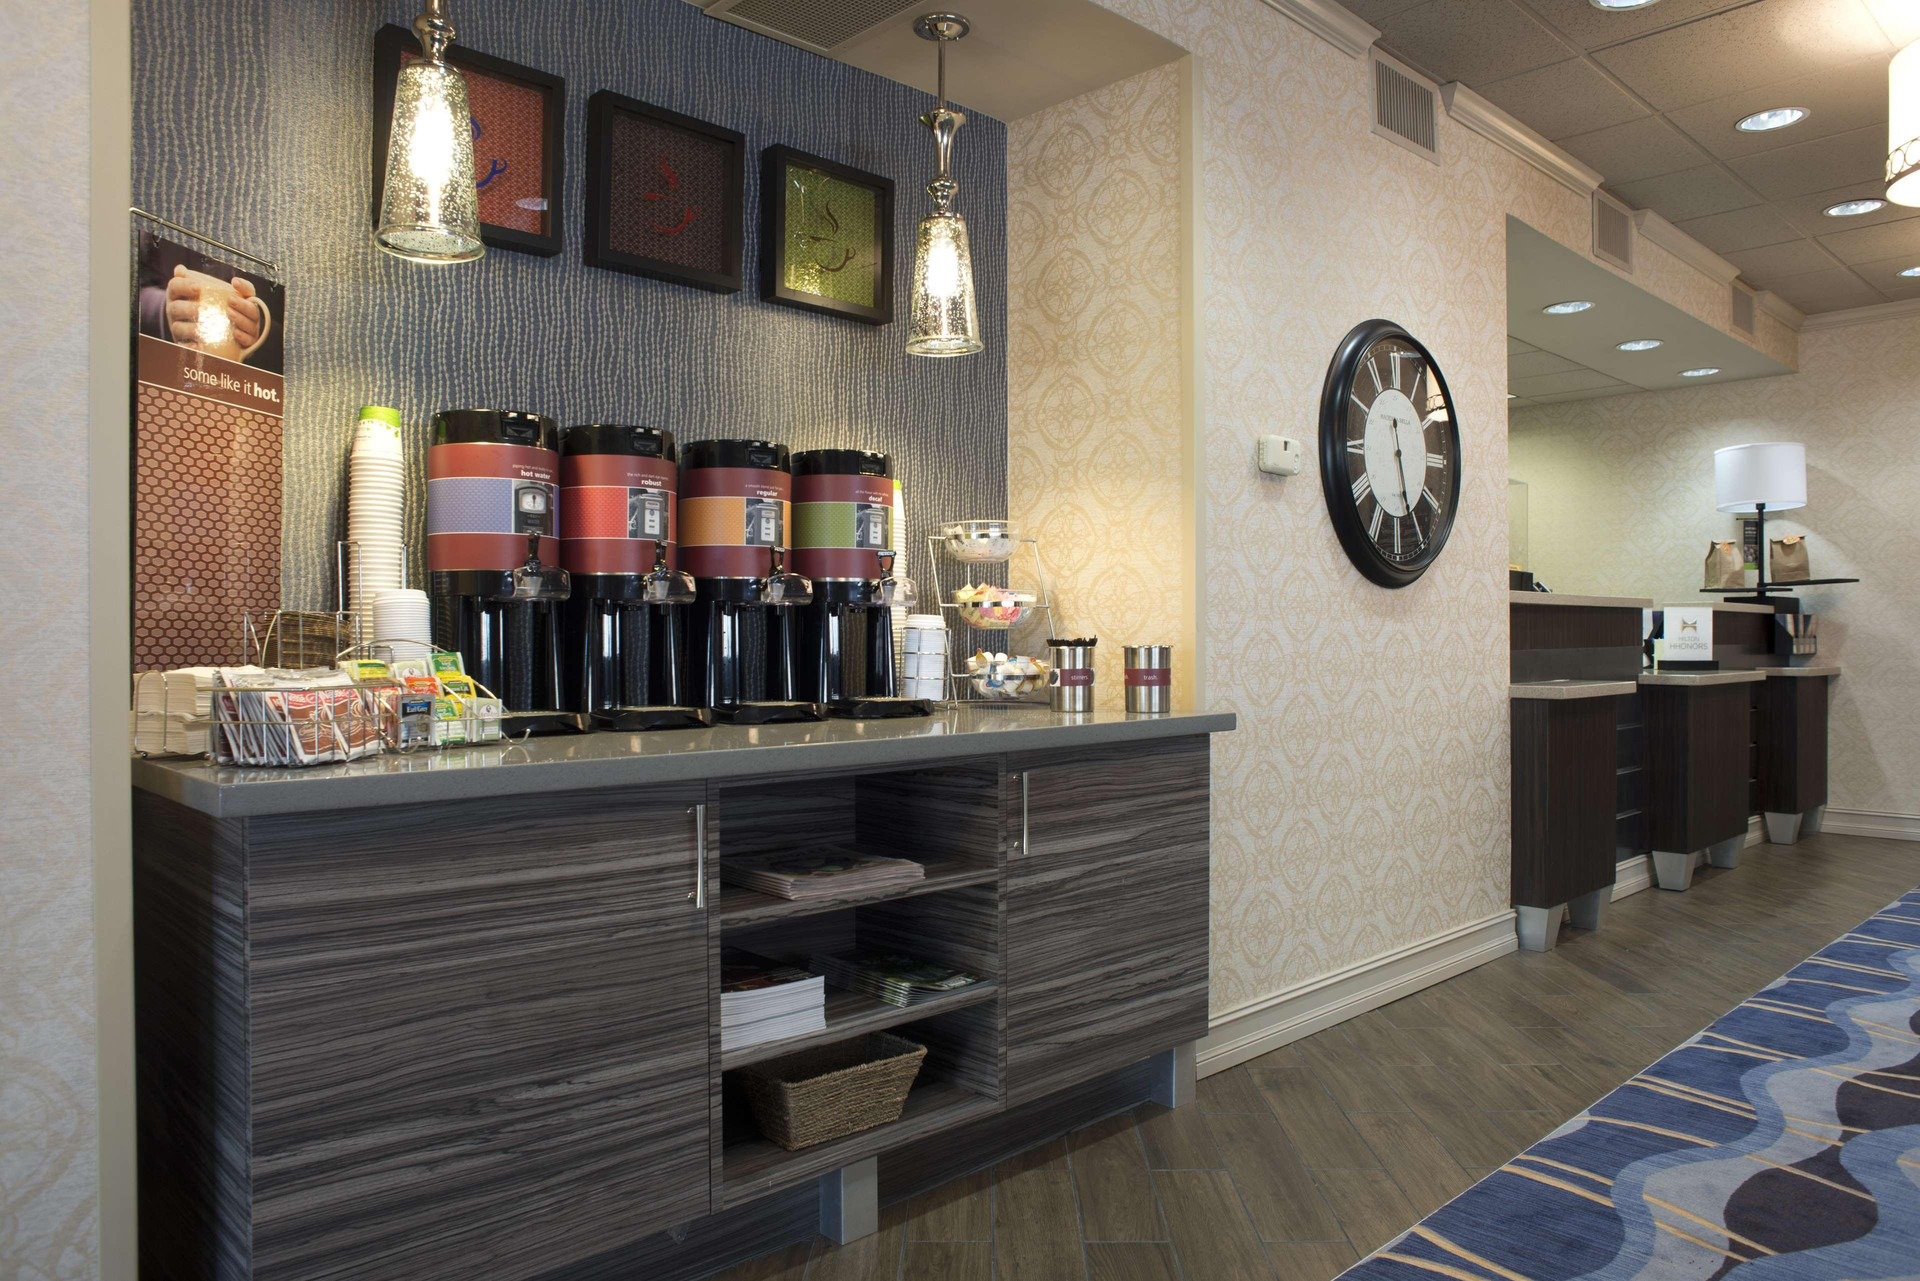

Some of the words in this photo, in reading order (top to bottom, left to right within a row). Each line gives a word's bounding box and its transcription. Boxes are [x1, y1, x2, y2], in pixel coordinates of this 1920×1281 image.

[183, 366, 217, 386] some
[220, 372, 241, 392] like
[243, 380, 252, 396] it
[253, 382, 280, 403] hot.
[521, 469, 533, 477] hot
[535, 472, 550, 480] water
[868, 495, 882, 503] decaf
